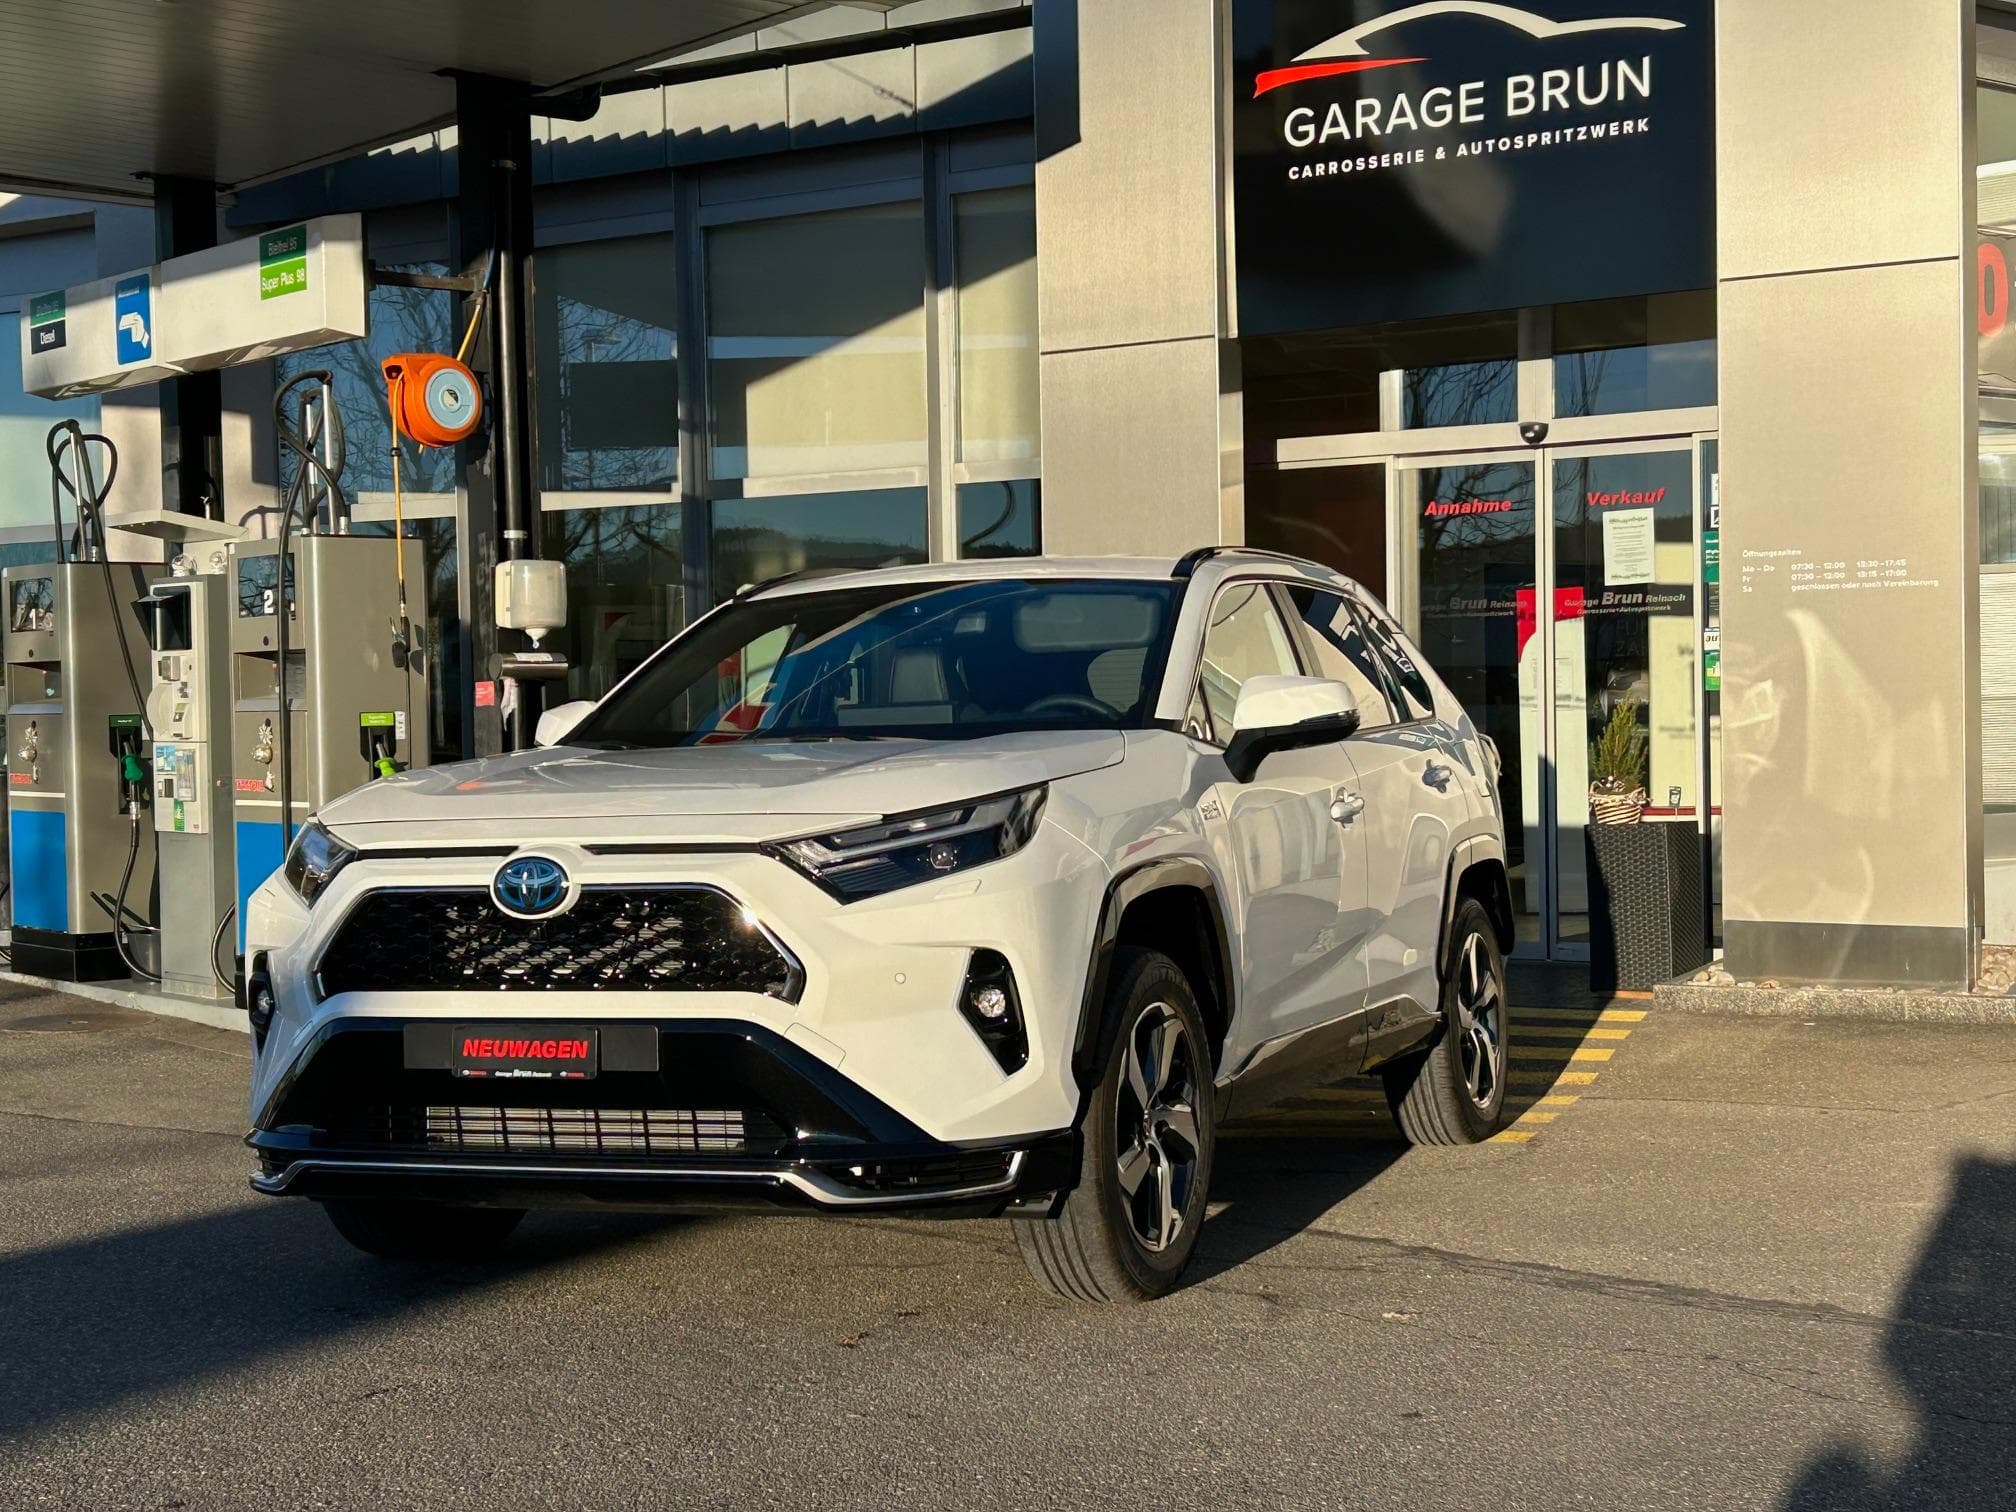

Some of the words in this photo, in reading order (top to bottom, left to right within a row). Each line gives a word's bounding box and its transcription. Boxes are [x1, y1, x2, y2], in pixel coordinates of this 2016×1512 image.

[1284, 80, 1485, 147] GARAGE
[1506, 55, 1650, 117] BRUN
[1288, 149, 1425, 180] CARROSSERIE
[1435, 146, 1446, 160] &
[1456, 117, 1650, 157] AUTOSPRITZWERK
[262, 277, 280, 293] Super
[281, 271, 294, 287] Plus
[1587, 487, 1665, 506] Verkauf
[1424, 498, 1513, 516] Annahme
[1883, 579, 1939, 588] Vereinbarung
[263, 589, 274, 614] 2
[1450, 596, 1487, 609] Brun
[1601, 591, 1642, 605] Brun
[1645, 593, 1686, 603] Reinach
[29, 608, 37, 630] 1
[462, 1039, 589, 1059] NEUWAGEN
